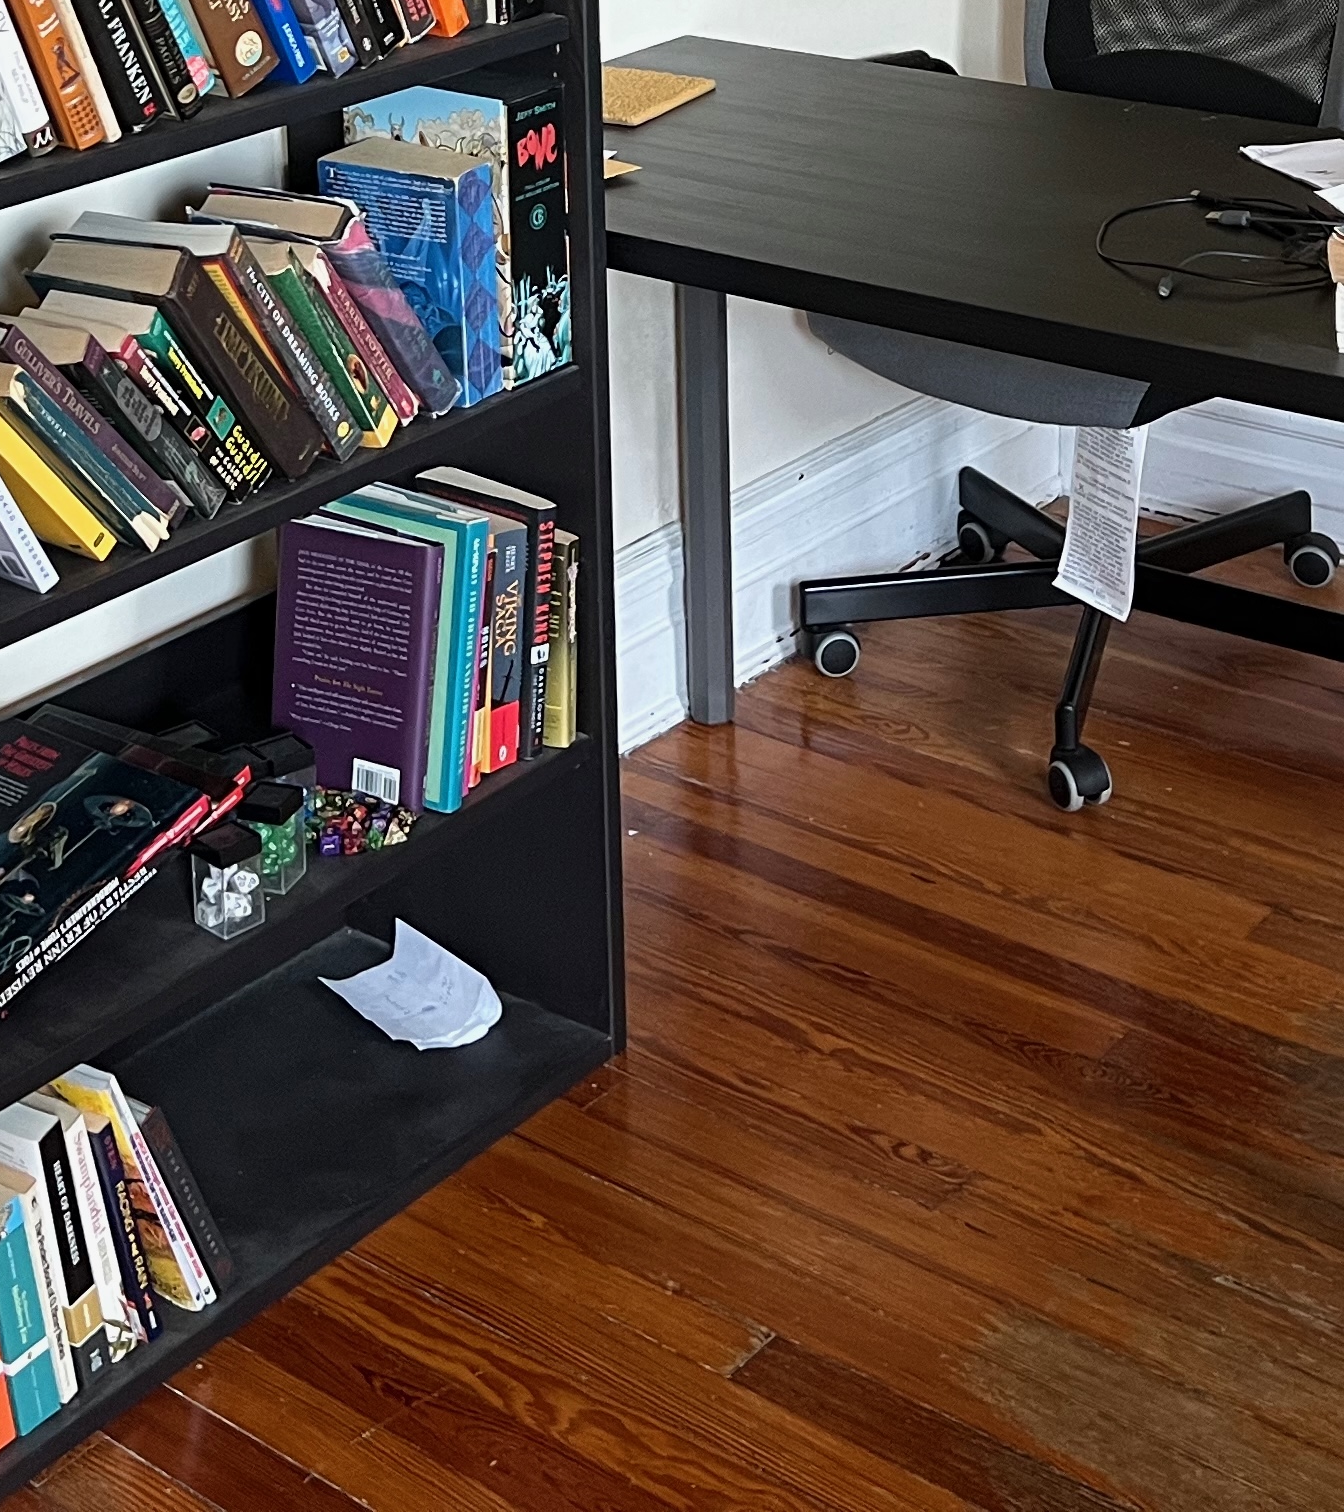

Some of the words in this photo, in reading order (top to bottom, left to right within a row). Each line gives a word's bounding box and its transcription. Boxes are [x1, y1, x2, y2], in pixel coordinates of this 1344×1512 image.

[107, 17, 151, 103] FRANKEN
[516, 124, 557, 170] BONE
[246, 266, 260, 285] The
[254, 282, 274, 309] CITY
[272, 309, 284, 326] OF
[277, 324, 322, 387] DREAMING
[14, 336, 62, 394] GULLIVER'S
[62, 387, 100, 434] TRAVELS
[310, 383, 342, 422] BOOKS
[536, 520, 555, 596] STEPHEN
[492, 594, 507, 648] SAGA
[502, 579, 518, 655] VIKING
[533, 601, 551, 644] KING
[38, 922, 82, 966] KRYNN
[52, 1159, 66, 1196] HEART
[60, 1195, 68, 1209] OF
[70, 1129, 105, 1239] Swamplandia!
[62, 1210, 80, 1266] DARKNESS
[116, 1180, 133, 1232] RACING
[134, 1255, 147, 1289] RAIN
